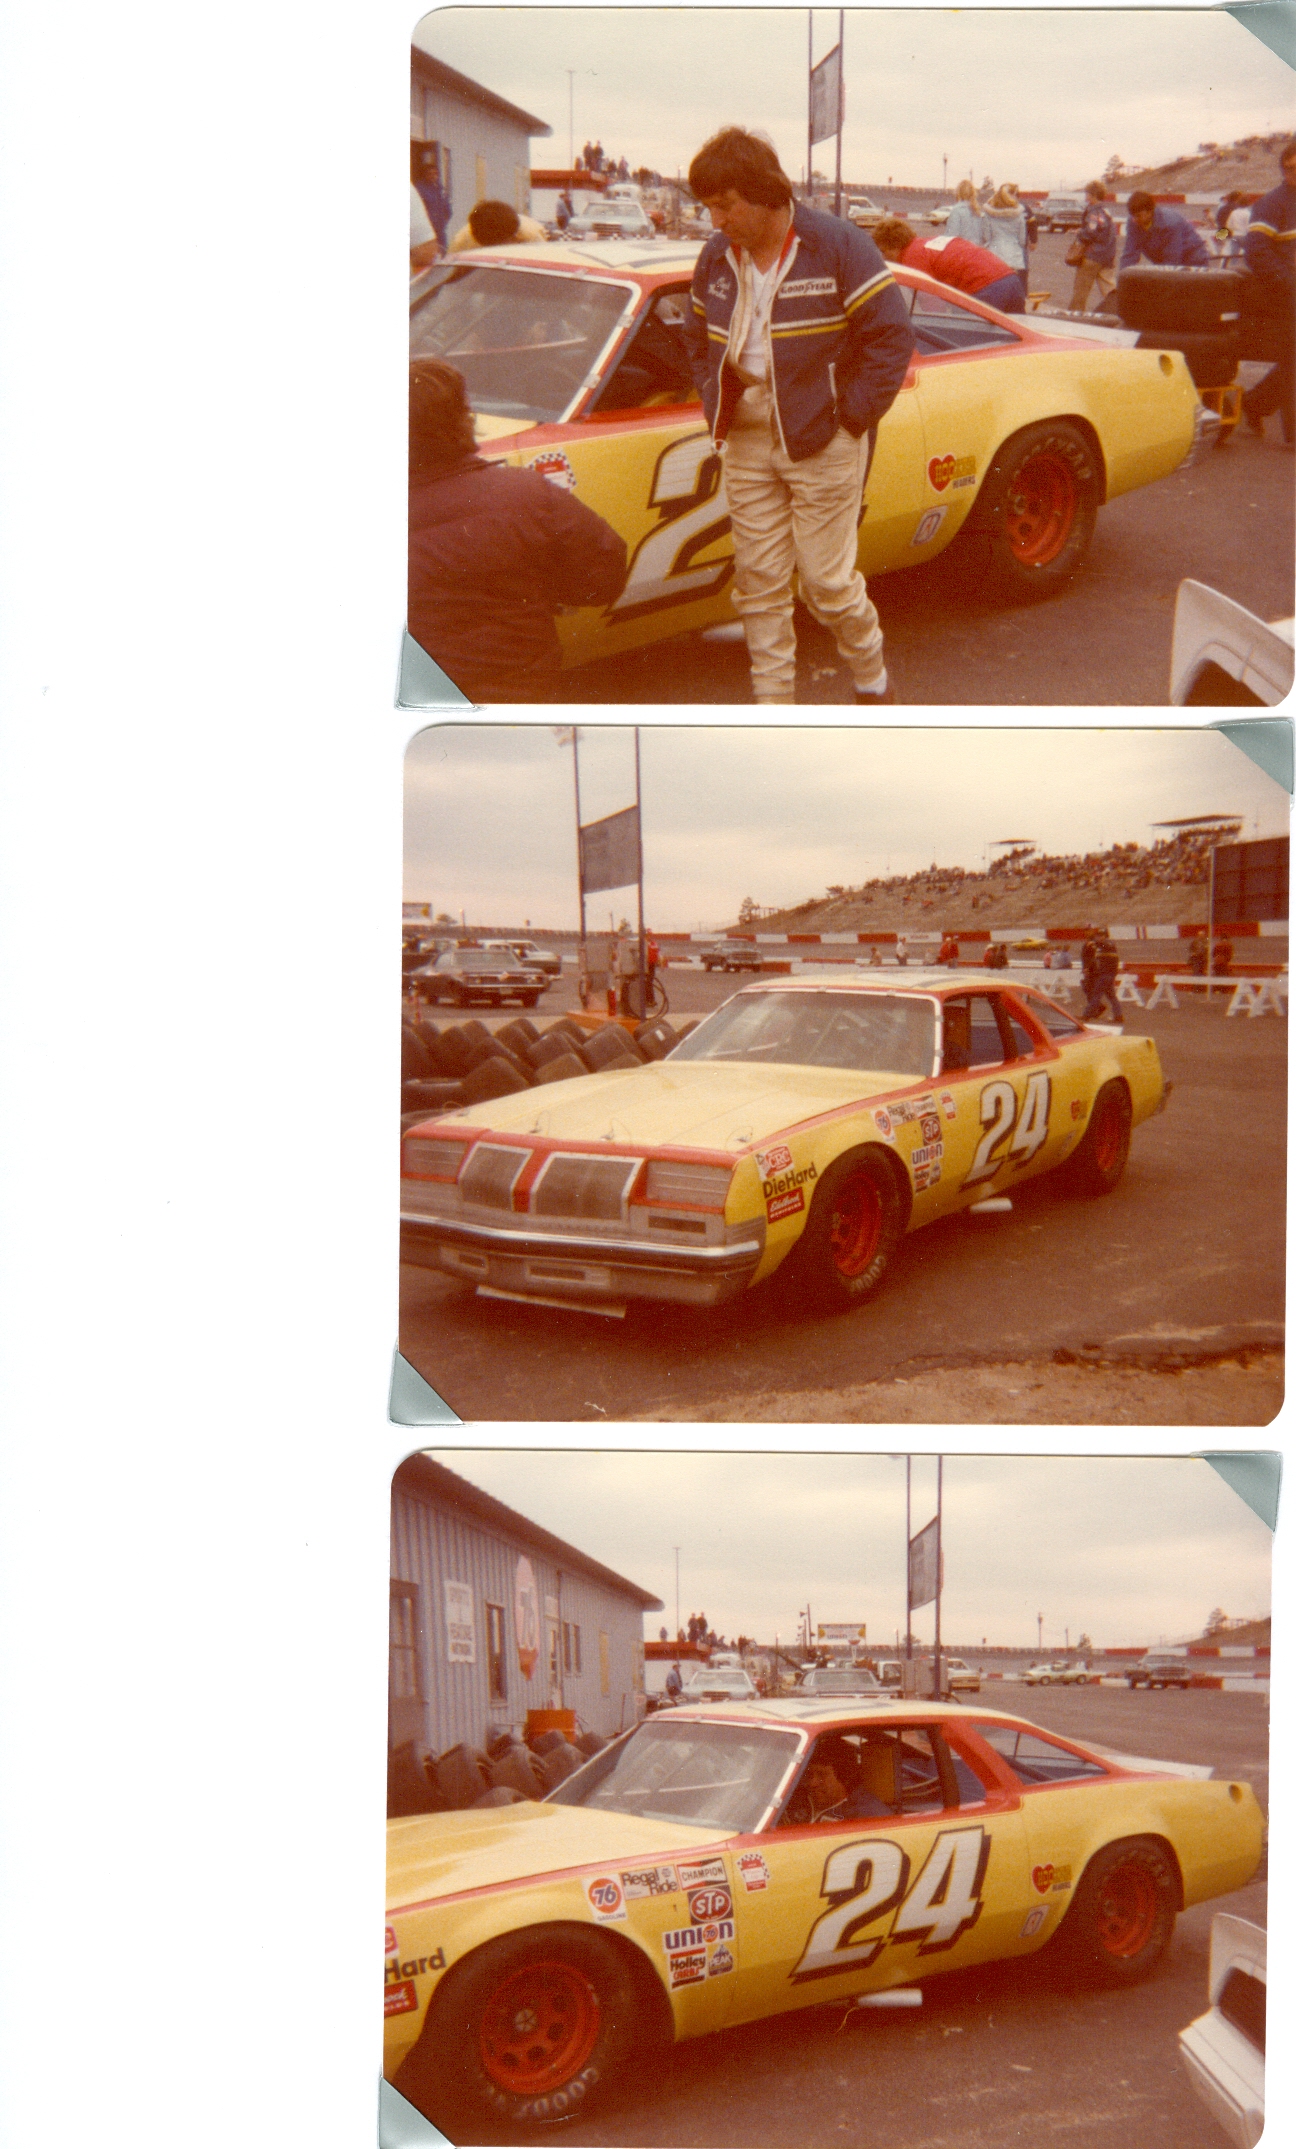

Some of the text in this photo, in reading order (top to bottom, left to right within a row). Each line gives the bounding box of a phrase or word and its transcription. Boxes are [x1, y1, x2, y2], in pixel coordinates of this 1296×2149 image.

[924, 1120, 939, 1138] STP
[958, 1069, 1052, 1193] 24
[768, 1150, 791, 1168] CRC
[762, 1161, 818, 1199] DieHard
[621, 1871, 660, 1888] Regal
[681, 1866, 723, 1882] CHAMPION
[593, 1884, 618, 1906] 76
[649, 1880, 678, 1896] Ride
[696, 1891, 725, 1915] STP
[788, 1825, 991, 1986] 24
[384, 1946, 447, 1984] Hard
[670, 1955, 706, 1973] Holley
